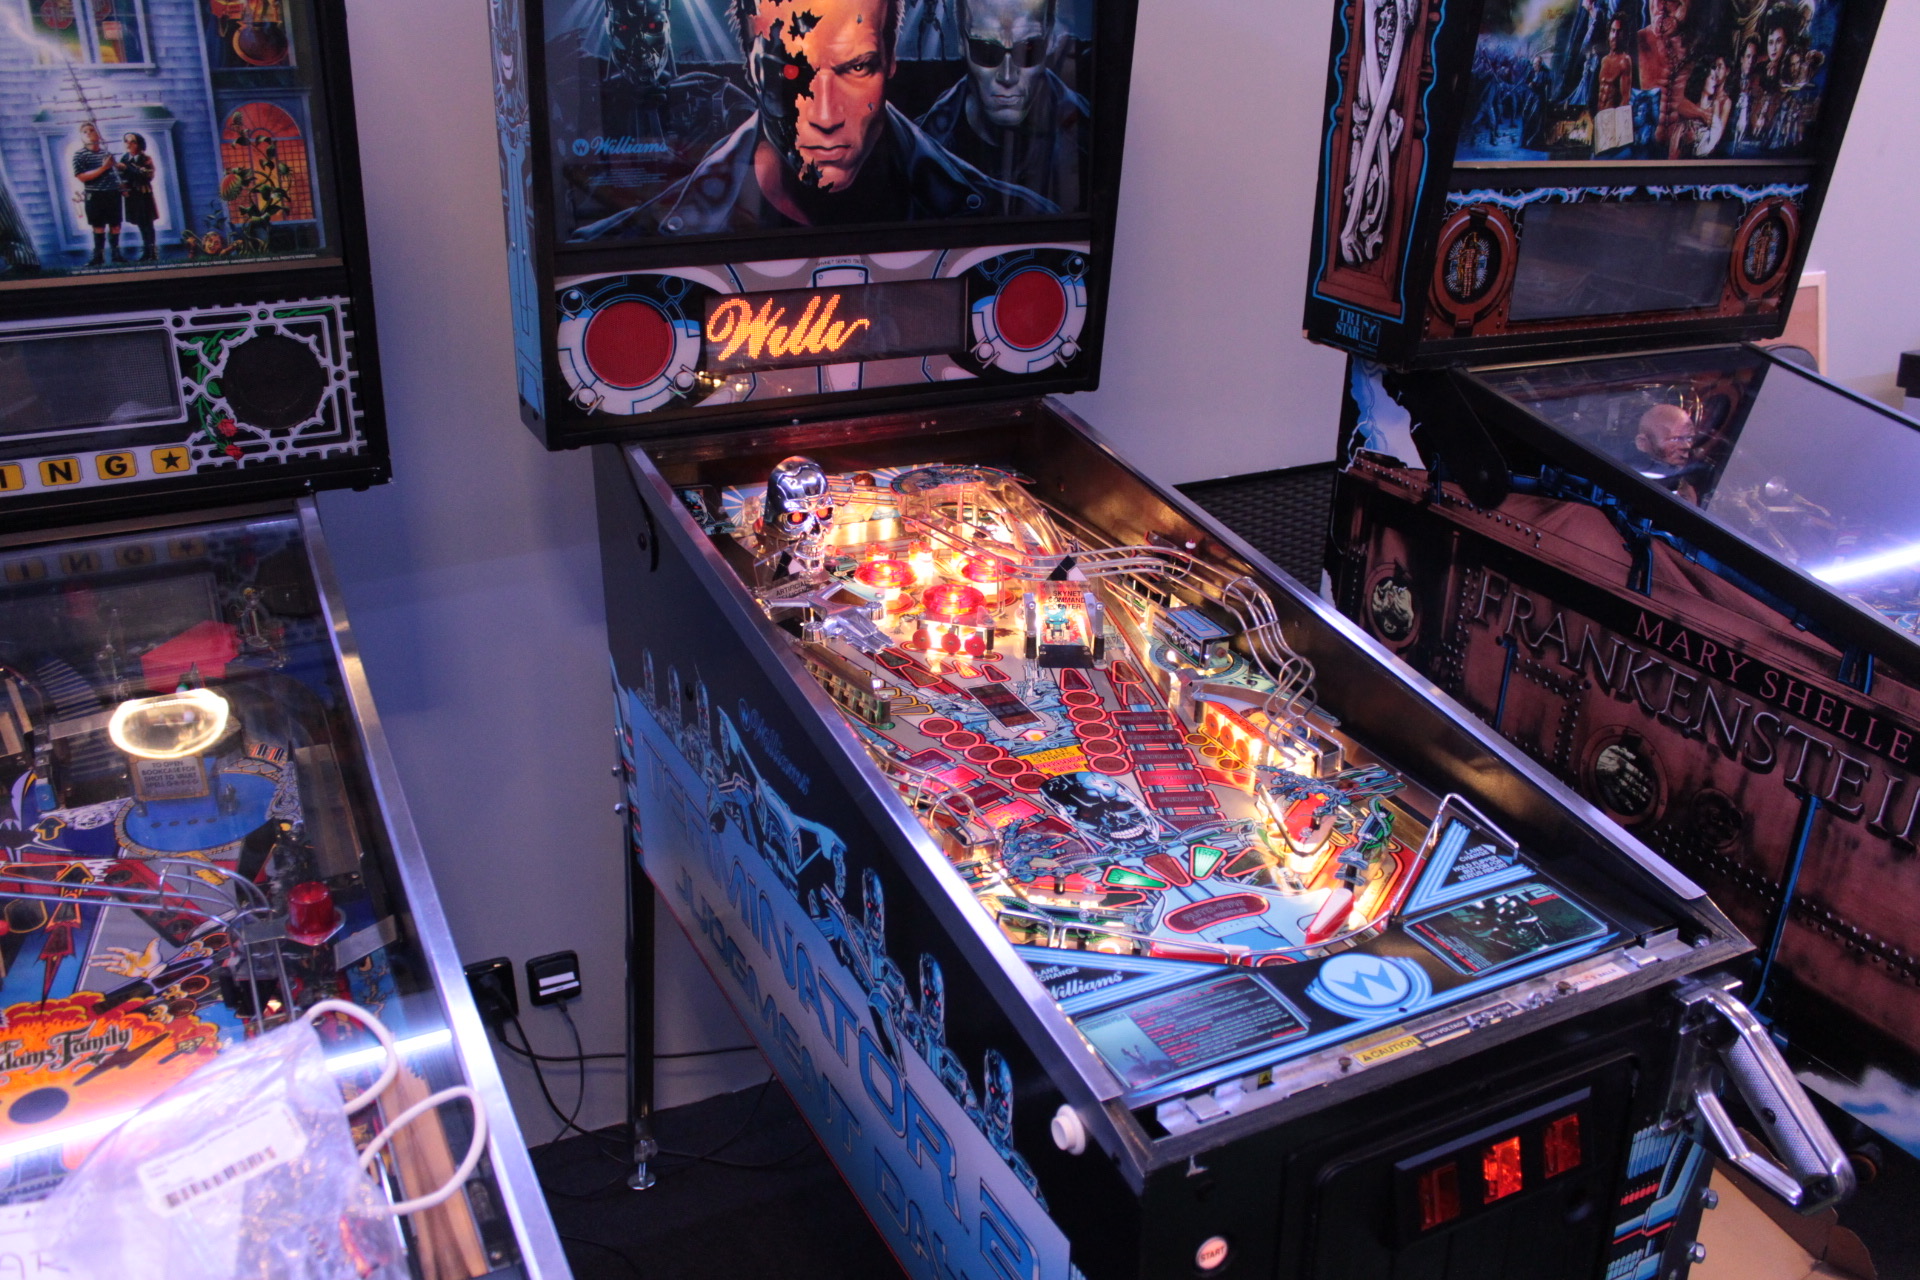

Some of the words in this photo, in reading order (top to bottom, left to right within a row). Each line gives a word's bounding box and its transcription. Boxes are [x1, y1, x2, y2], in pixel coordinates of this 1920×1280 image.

[590, 136, 669, 156] Williams
[1339, 308, 1360, 326] TRI
[1335, 320, 1360, 341] STAR
[1048, 596, 1086, 604] COMMAND
[1633, 611, 1751, 684] MARY
[1759, 669, 1913, 764] SHELLE
[1459, 849, 1490, 862] CHANGE
[1464, 845, 1485, 854] LANE
[1453, 861, 1473, 872] HOLD
[1458, 870, 1482, 881] STATUS
[1482, 864, 1508, 875] REPORT
[1463, 863, 1489, 874] BUTTON
[1507, 883, 1554, 902] T2
[640, 730, 961, 1224] TERMINATOR
[1035, 965, 1058, 976] LANE
[1038, 967, 1079, 983] CHANGE
[50, 1020, 133, 1071] Family
[1371, 1037, 1417, 1059] CAUTION
[1420, 1029, 1439, 1041] HIGH
[1437, 1020, 1467, 1034] VOLTAGE
[1200, 1246, 1225, 1262] START
